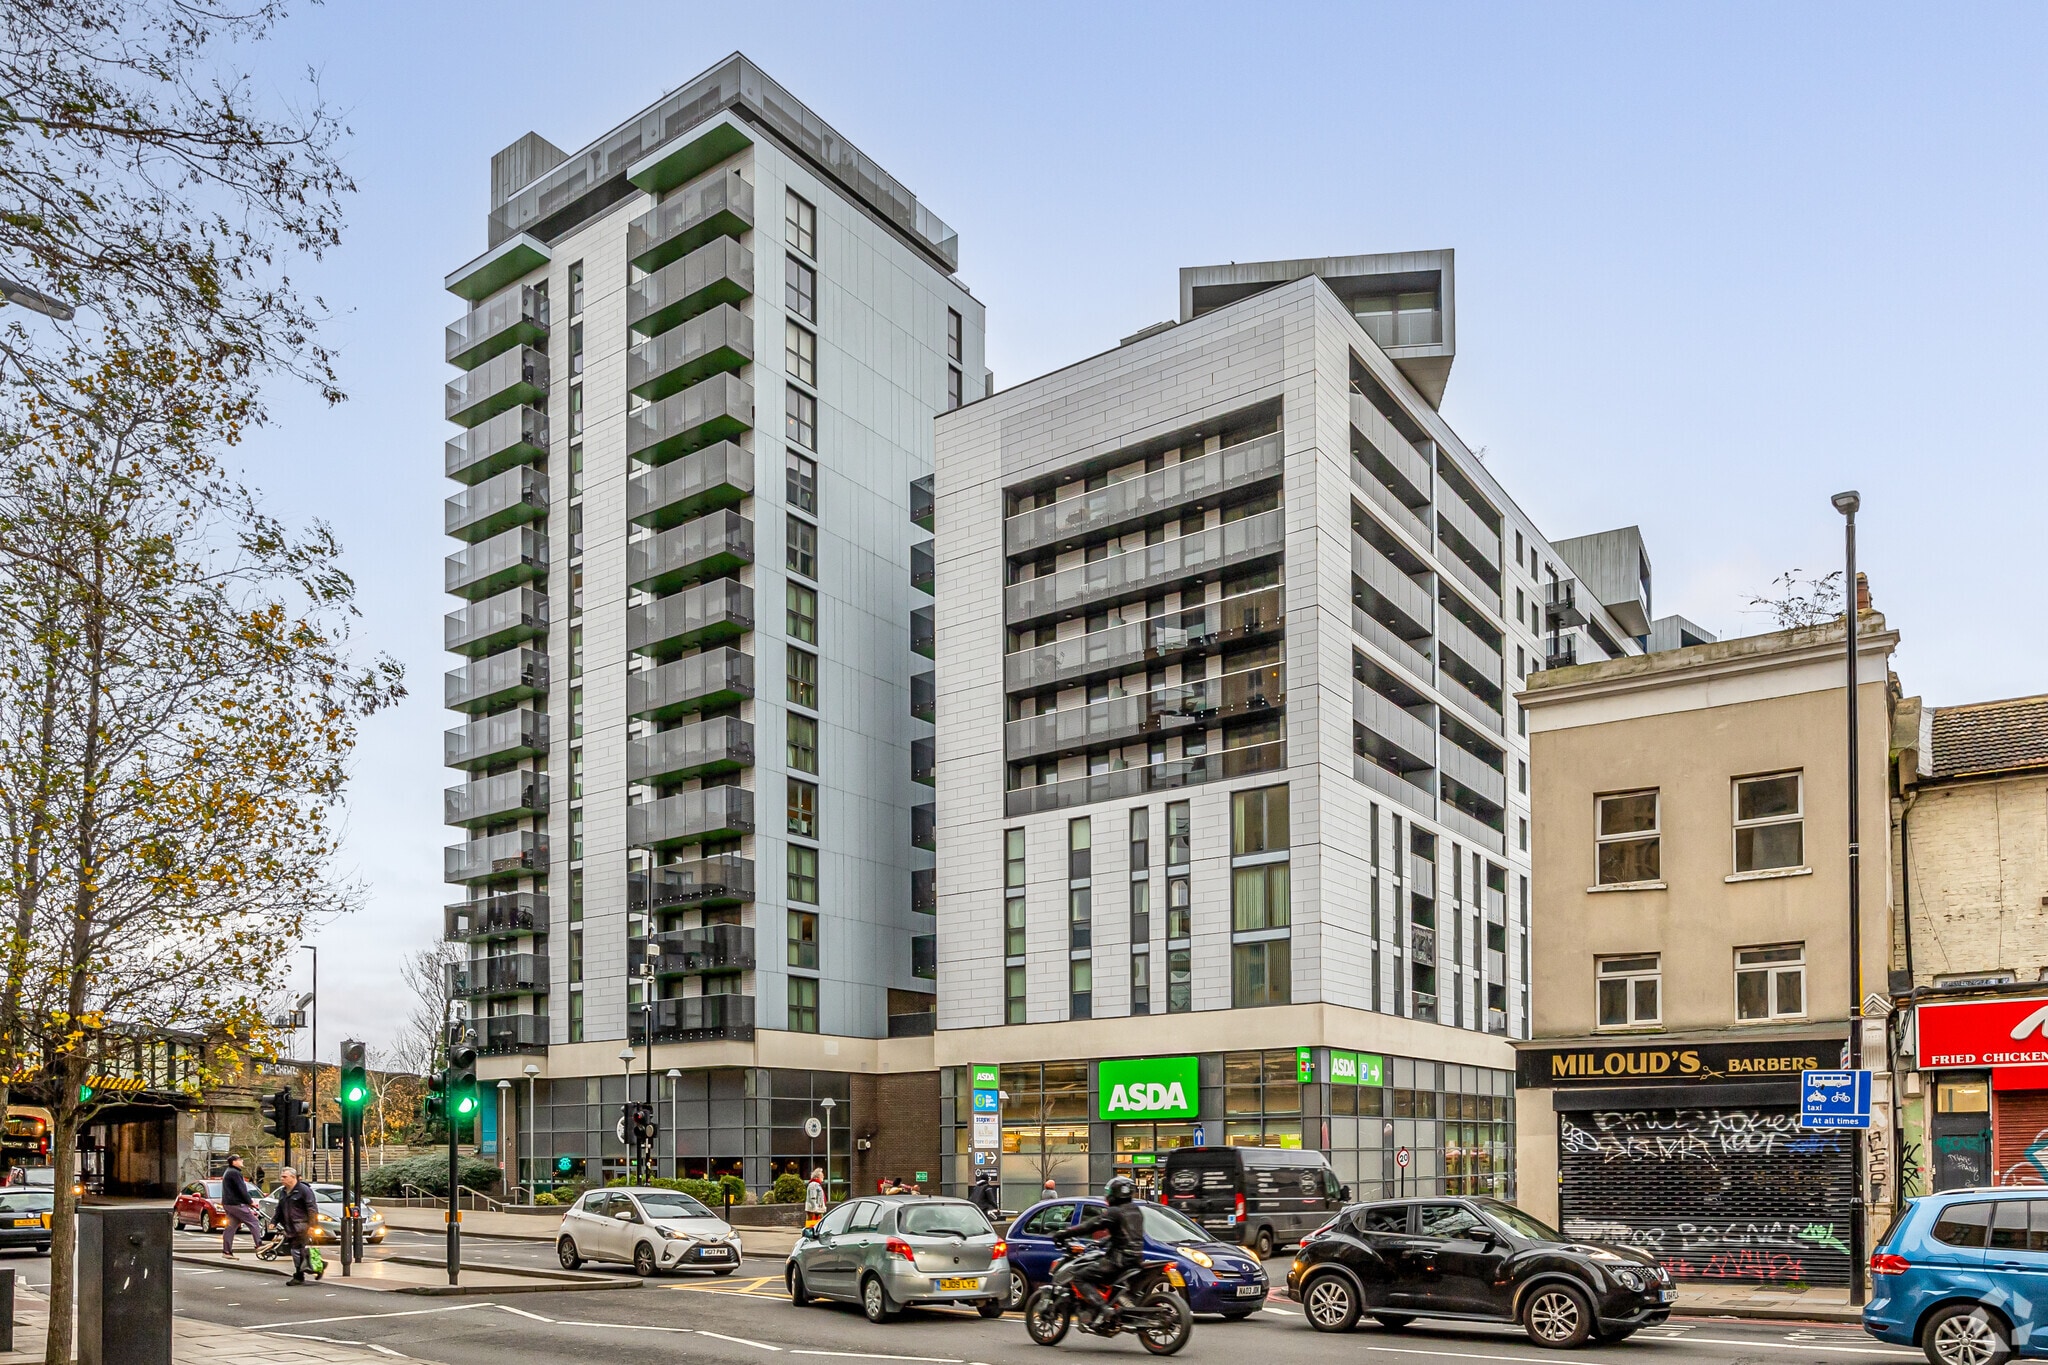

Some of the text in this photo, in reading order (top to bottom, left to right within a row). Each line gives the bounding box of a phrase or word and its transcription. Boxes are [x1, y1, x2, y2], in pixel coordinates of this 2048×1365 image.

[1552, 1050, 1818, 1077] MILOUD'S BARBERS
[1931, 1054, 1976, 1065] FRIED
[1332, 1058, 1356, 1077] ASDA
[976, 1072, 995, 1081] ASDA
[1107, 1081, 1188, 1112] ASDA
[1837, 1117, 1859, 1125] times
[1399, 1153, 1408, 1163] 20
[962, 1280, 977, 1289] LYZ
